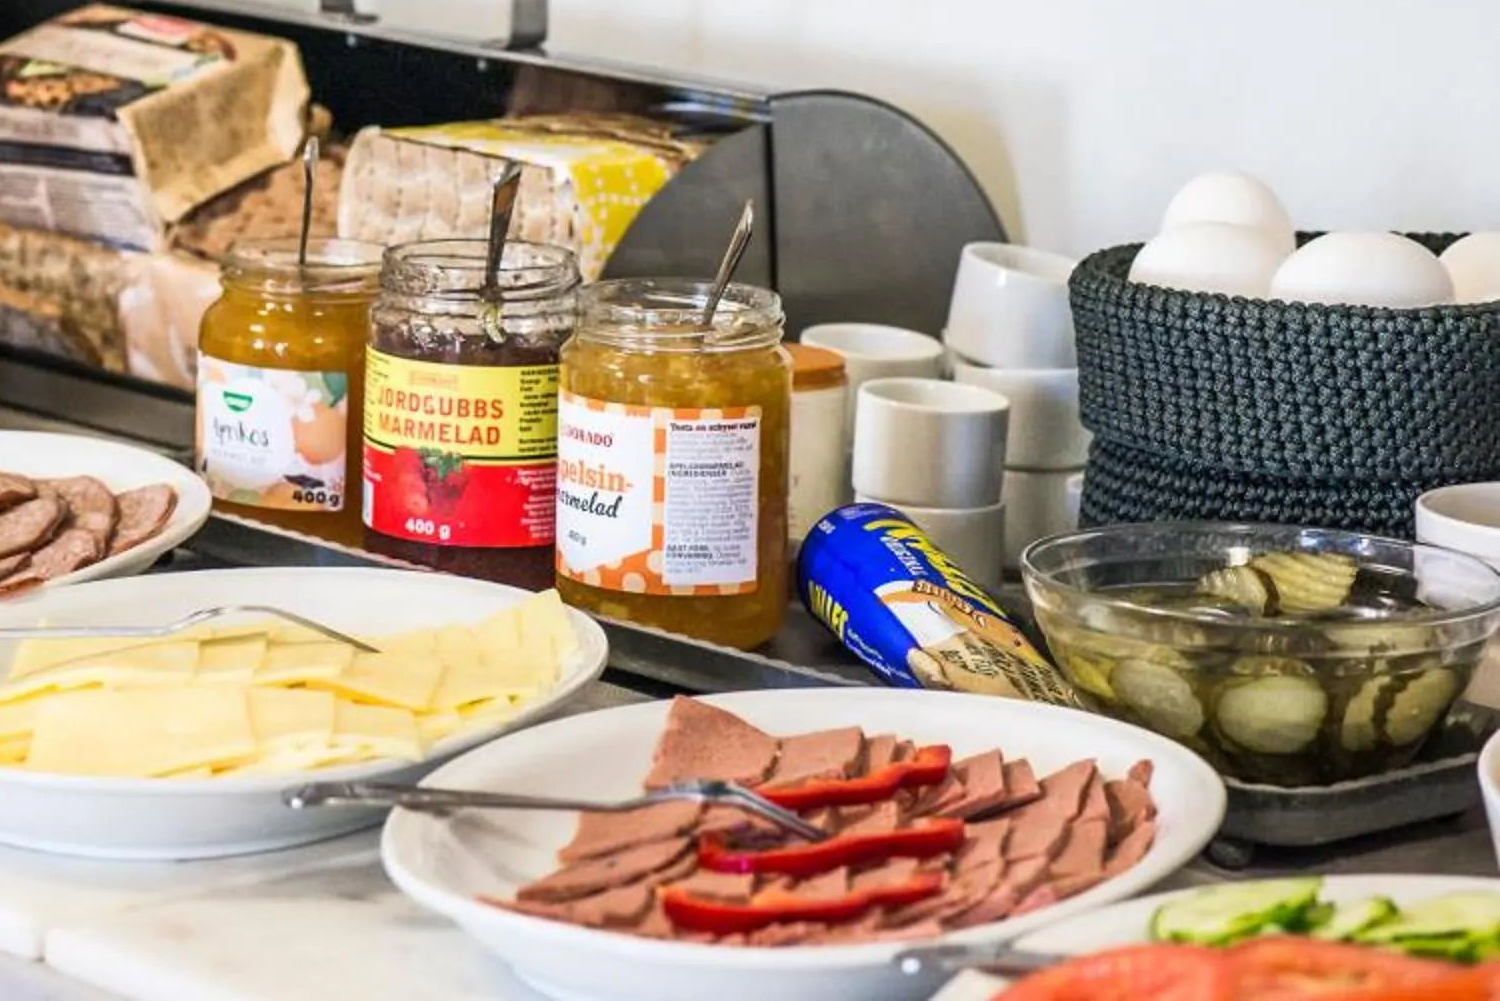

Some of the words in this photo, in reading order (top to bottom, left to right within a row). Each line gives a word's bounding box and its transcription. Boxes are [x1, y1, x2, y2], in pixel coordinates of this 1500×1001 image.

[378, 387, 504, 420] JORDGUBBS
[379, 412, 501, 445] MARMELAD
[558, 459, 633, 493] pelsin-
[405, 518, 435, 536] 400
[439, 524, 451, 540] g
